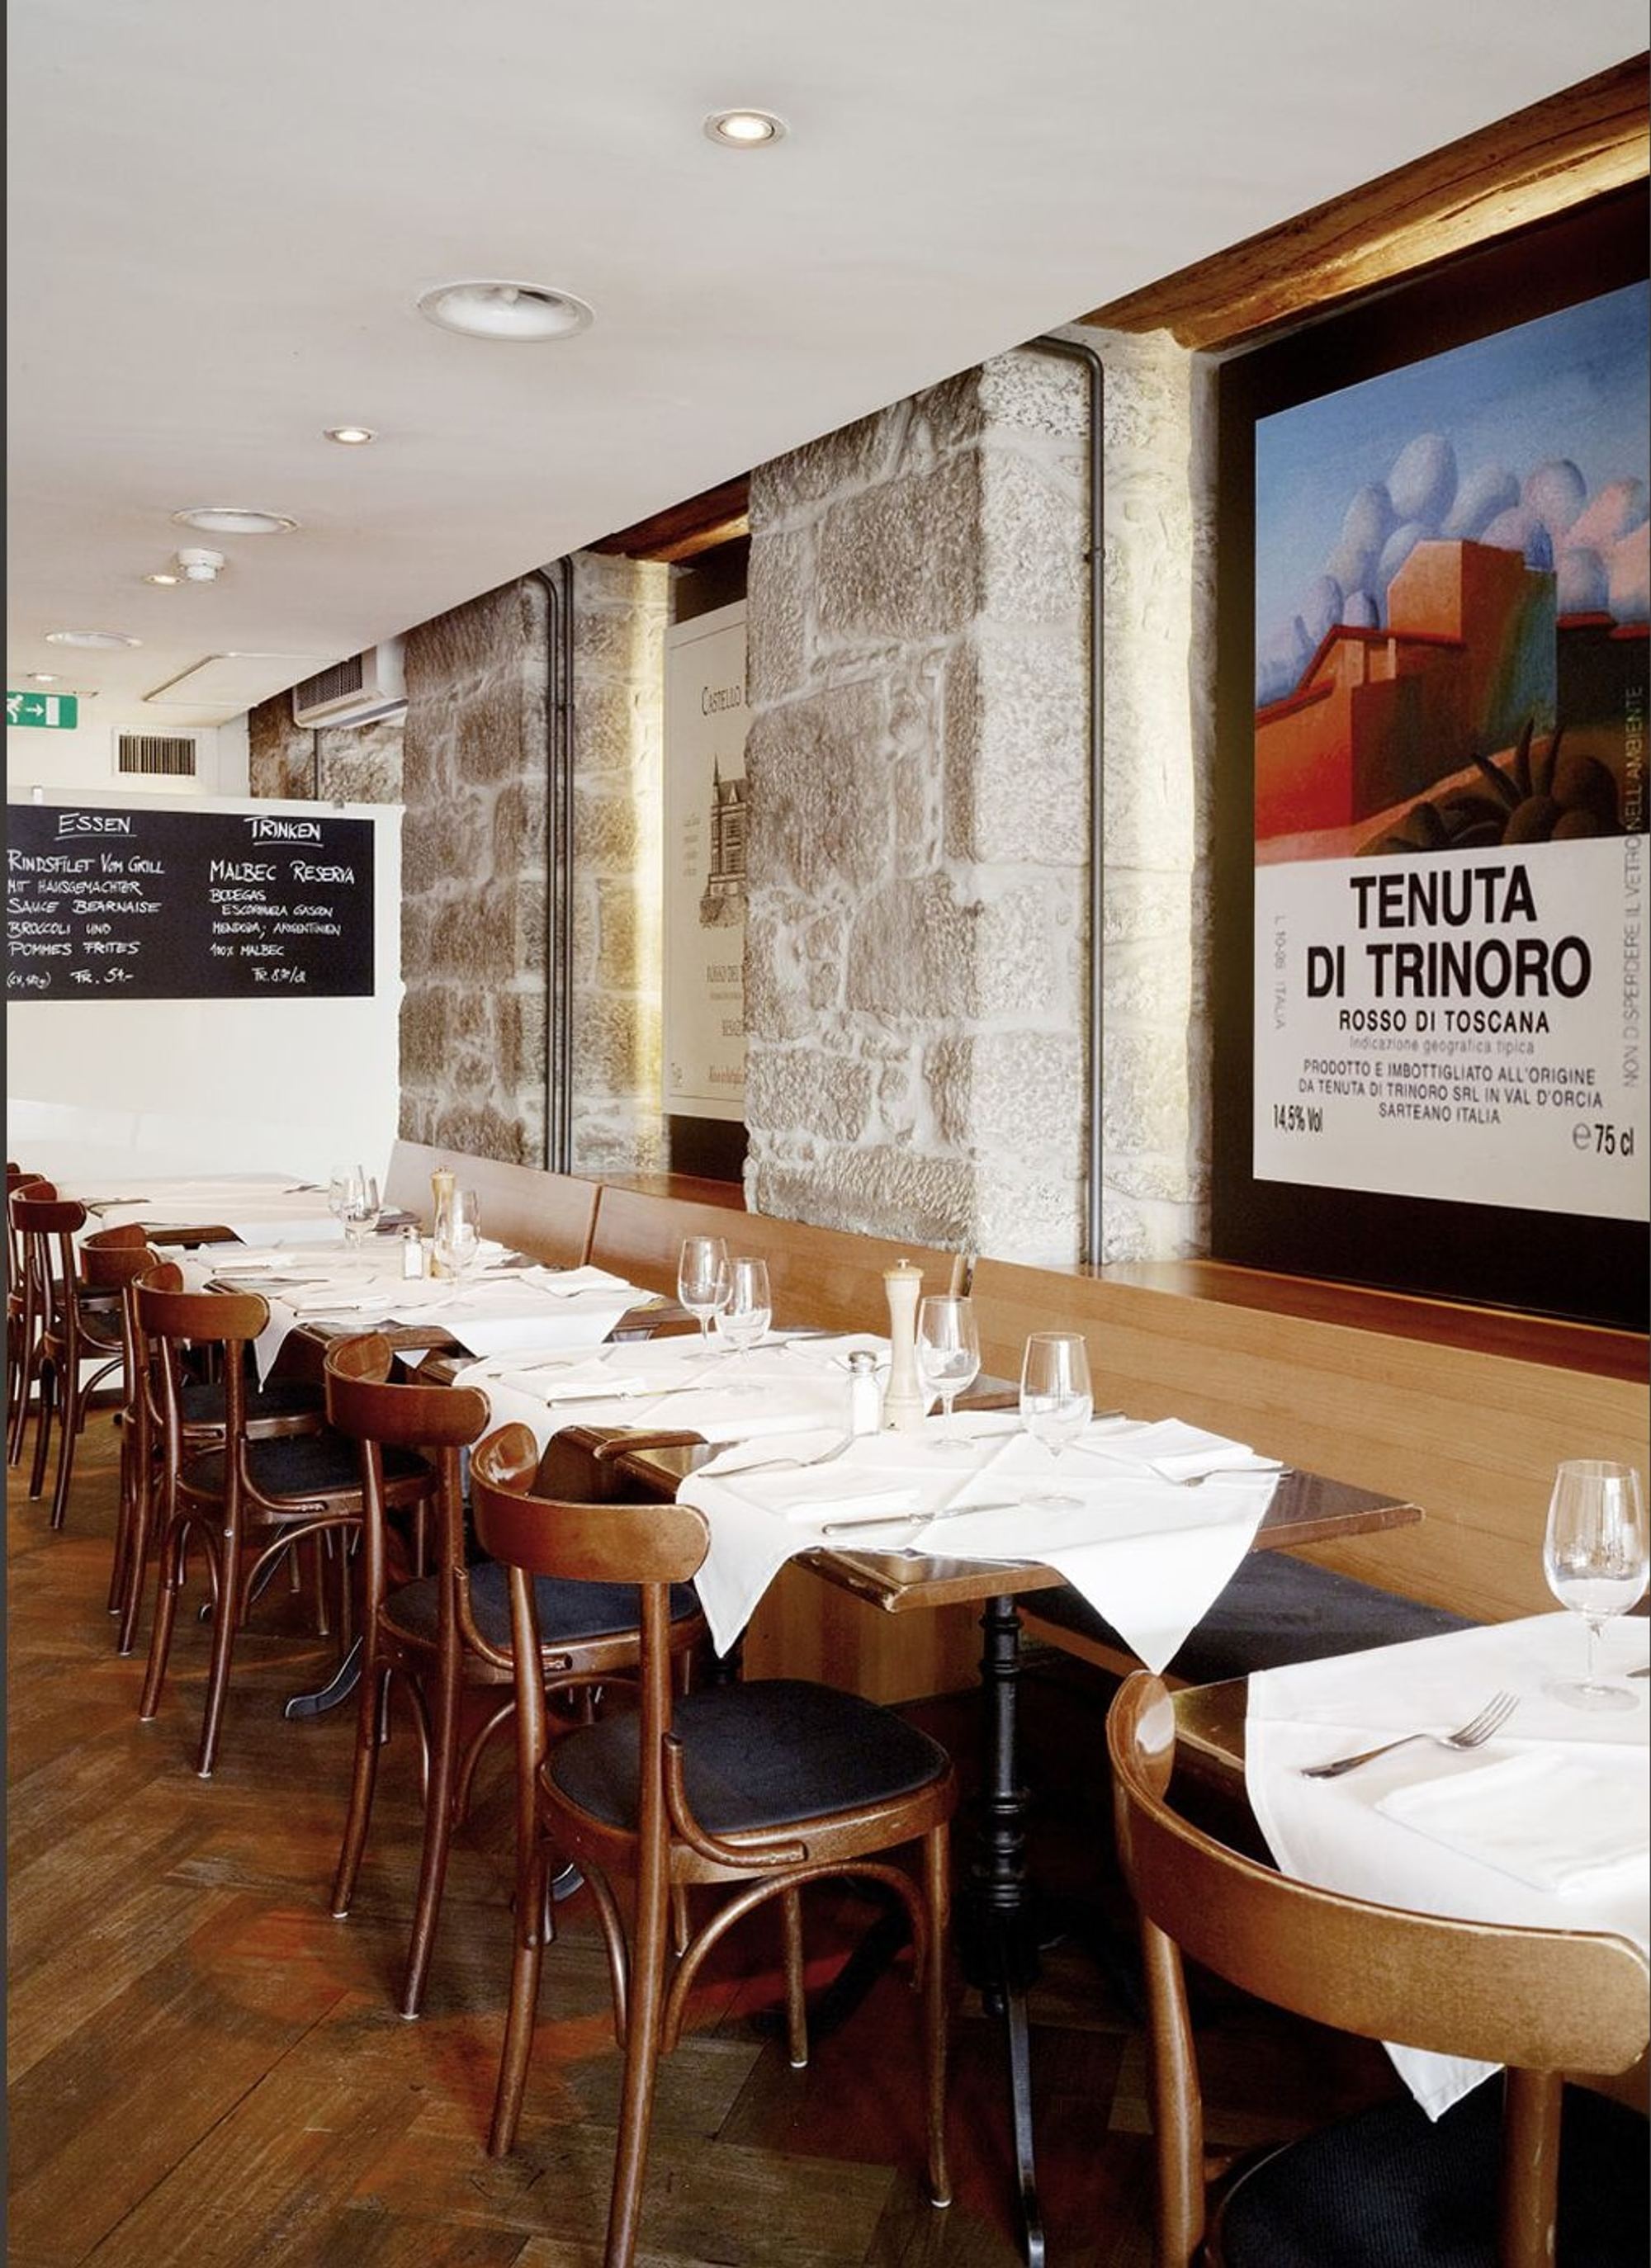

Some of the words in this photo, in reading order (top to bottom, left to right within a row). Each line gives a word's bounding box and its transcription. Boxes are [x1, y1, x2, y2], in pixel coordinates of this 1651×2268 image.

[1624, 685, 1644, 832] NELL'AMBIENTE
[59, 813, 130, 834] ESSEN
[244, 815, 321, 840] TRINKEN
[128, 855, 165, 873] GRILL
[209, 860, 277, 883] MALBEC
[290, 860, 356, 885] RESERVA
[1624, 836, 1641, 898] VETRO
[7, 879, 31, 895] MIT
[209, 889, 267, 904] BODEGAS
[1350, 865, 1538, 929] TENUTA
[7, 897, 59, 914] SAUCE
[1624, 902, 1641, 917] IL
[7, 921, 71, 938] BROCCOLI
[7, 942, 73, 956] POMMES
[83, 942, 141, 955] FRITES
[240, 945, 286, 957] MALBEC
[1307, 945, 1346, 999] DI
[1365, 936, 1592, 999] TRINORO
[1274, 981, 1286, 1030] ITALIA
[1340, 1009, 1407, 1032] ROSSO
[1416, 1010, 1436, 1032] DI
[1444, 1010, 1550, 1034] TOSCANA
[1350, 1035, 1419, 1051] Indicazione
[1423, 1037, 1491, 1056] geografica
[1497, 1039, 1535, 1056] tipica
[1303, 1059, 1370, 1077] PRODOTTO
[1375, 1061, 1383, 1077] E
[1388, 1062, 1493, 1081] IMBOTTIGLIATO
[1497, 1065, 1596, 1085] ALL'ORIGINE
[1623, 1045, 1640, 1088] NON
[1299, 1078, 1314, 1093] DA
[1318, 1079, 1365, 1096] TENUTA
[1370, 1081, 1383, 1097] DI
[1387, 1082, 1448, 1101] TRINORO
[1452, 1085, 1479, 1103] SRL
[1485, 1088, 1499, 1103] IN
[1503, 1088, 1530, 1105] VAL
[1537, 1089, 1603, 1108] D'ORCIA
[1308, 1106, 1323, 1133] Vol
[1379, 1102, 1452, 1122] SARTEANO
[1457, 1107, 1501, 1124] ITALIA
[1594, 1123, 1616, 1155] 75
[1620, 1127, 1634, 1156] cl
